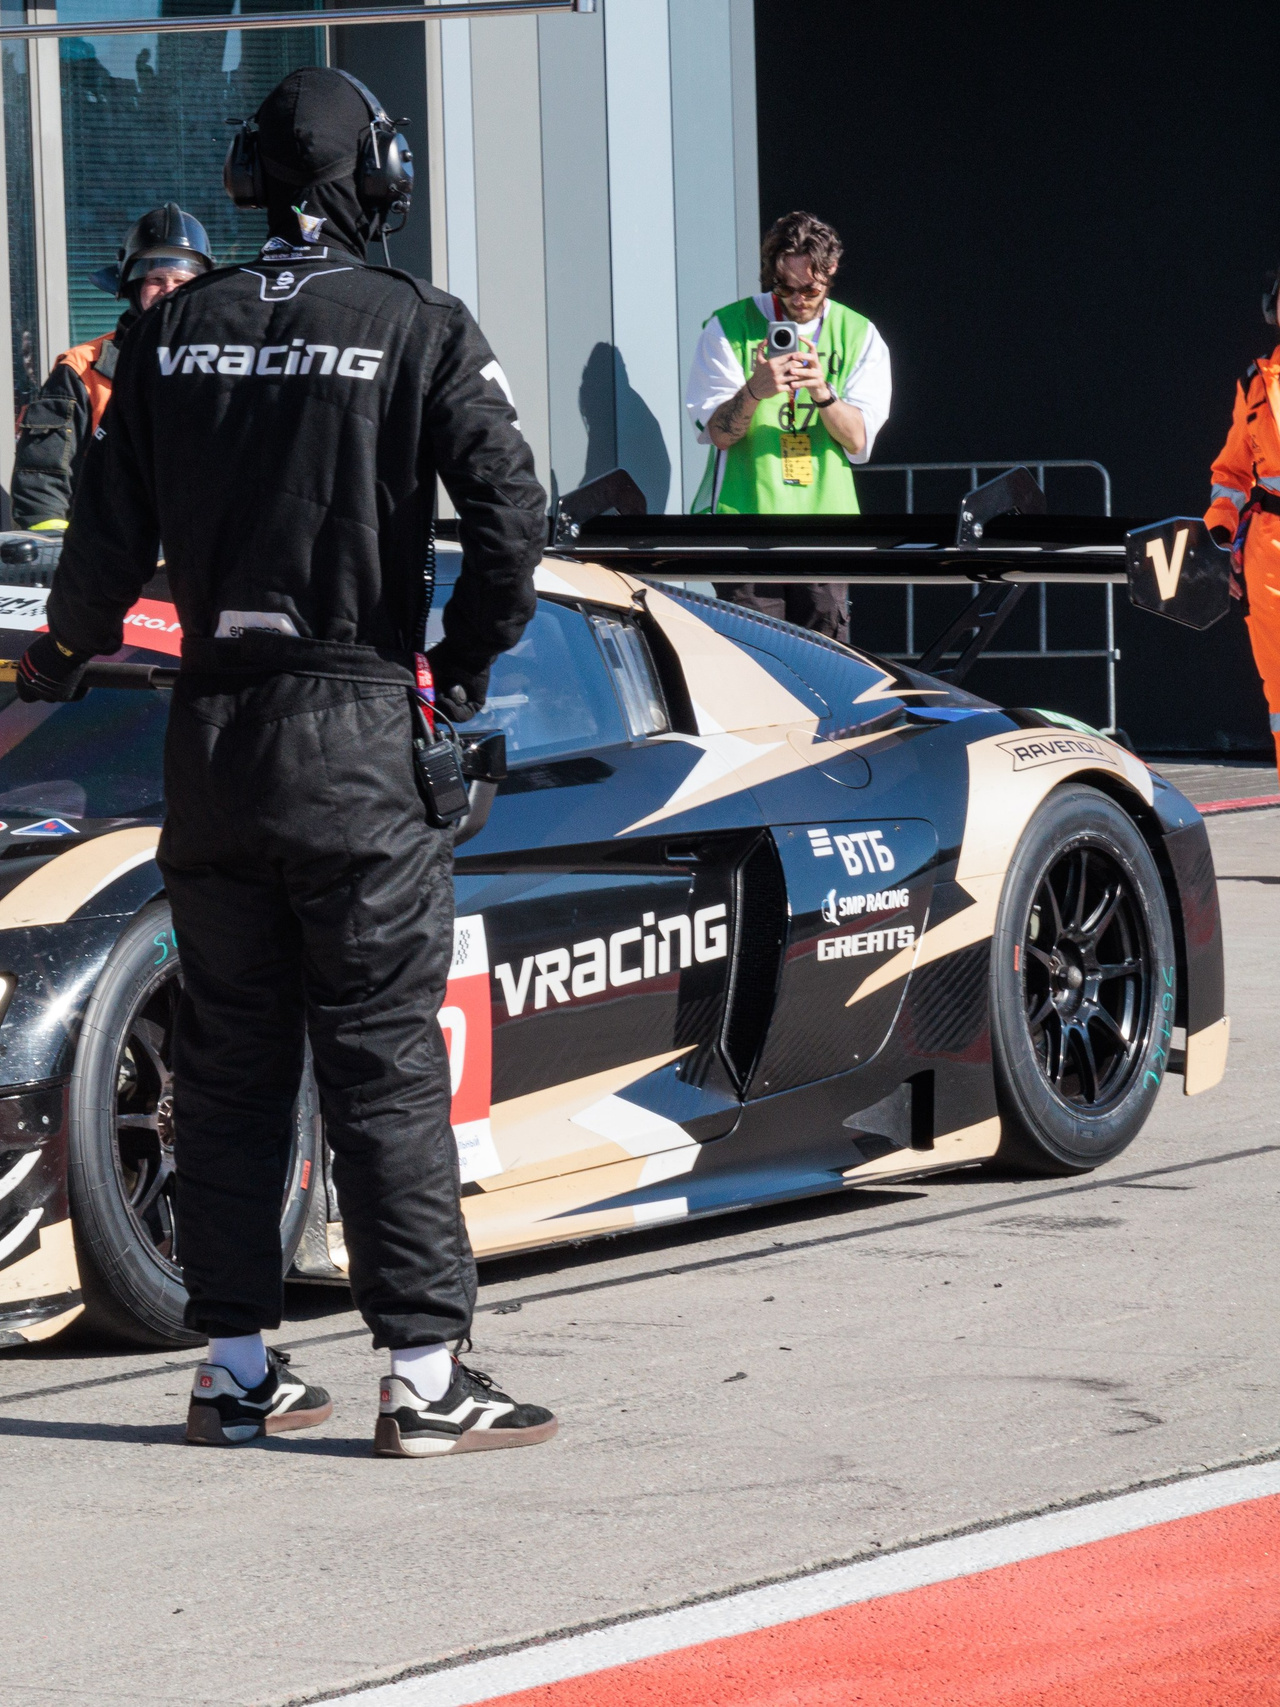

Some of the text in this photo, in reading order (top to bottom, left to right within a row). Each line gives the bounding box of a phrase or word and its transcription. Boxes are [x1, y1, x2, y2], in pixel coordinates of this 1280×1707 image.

[778, 402, 817, 432] 67
[1146, 528, 1189, 601] V
[1013, 740, 1104, 762] RAVENOL
[833, 829, 896, 877] ВТБ
[838, 888, 910, 917] SMP RACING
[817, 924, 916, 962] GREATS
